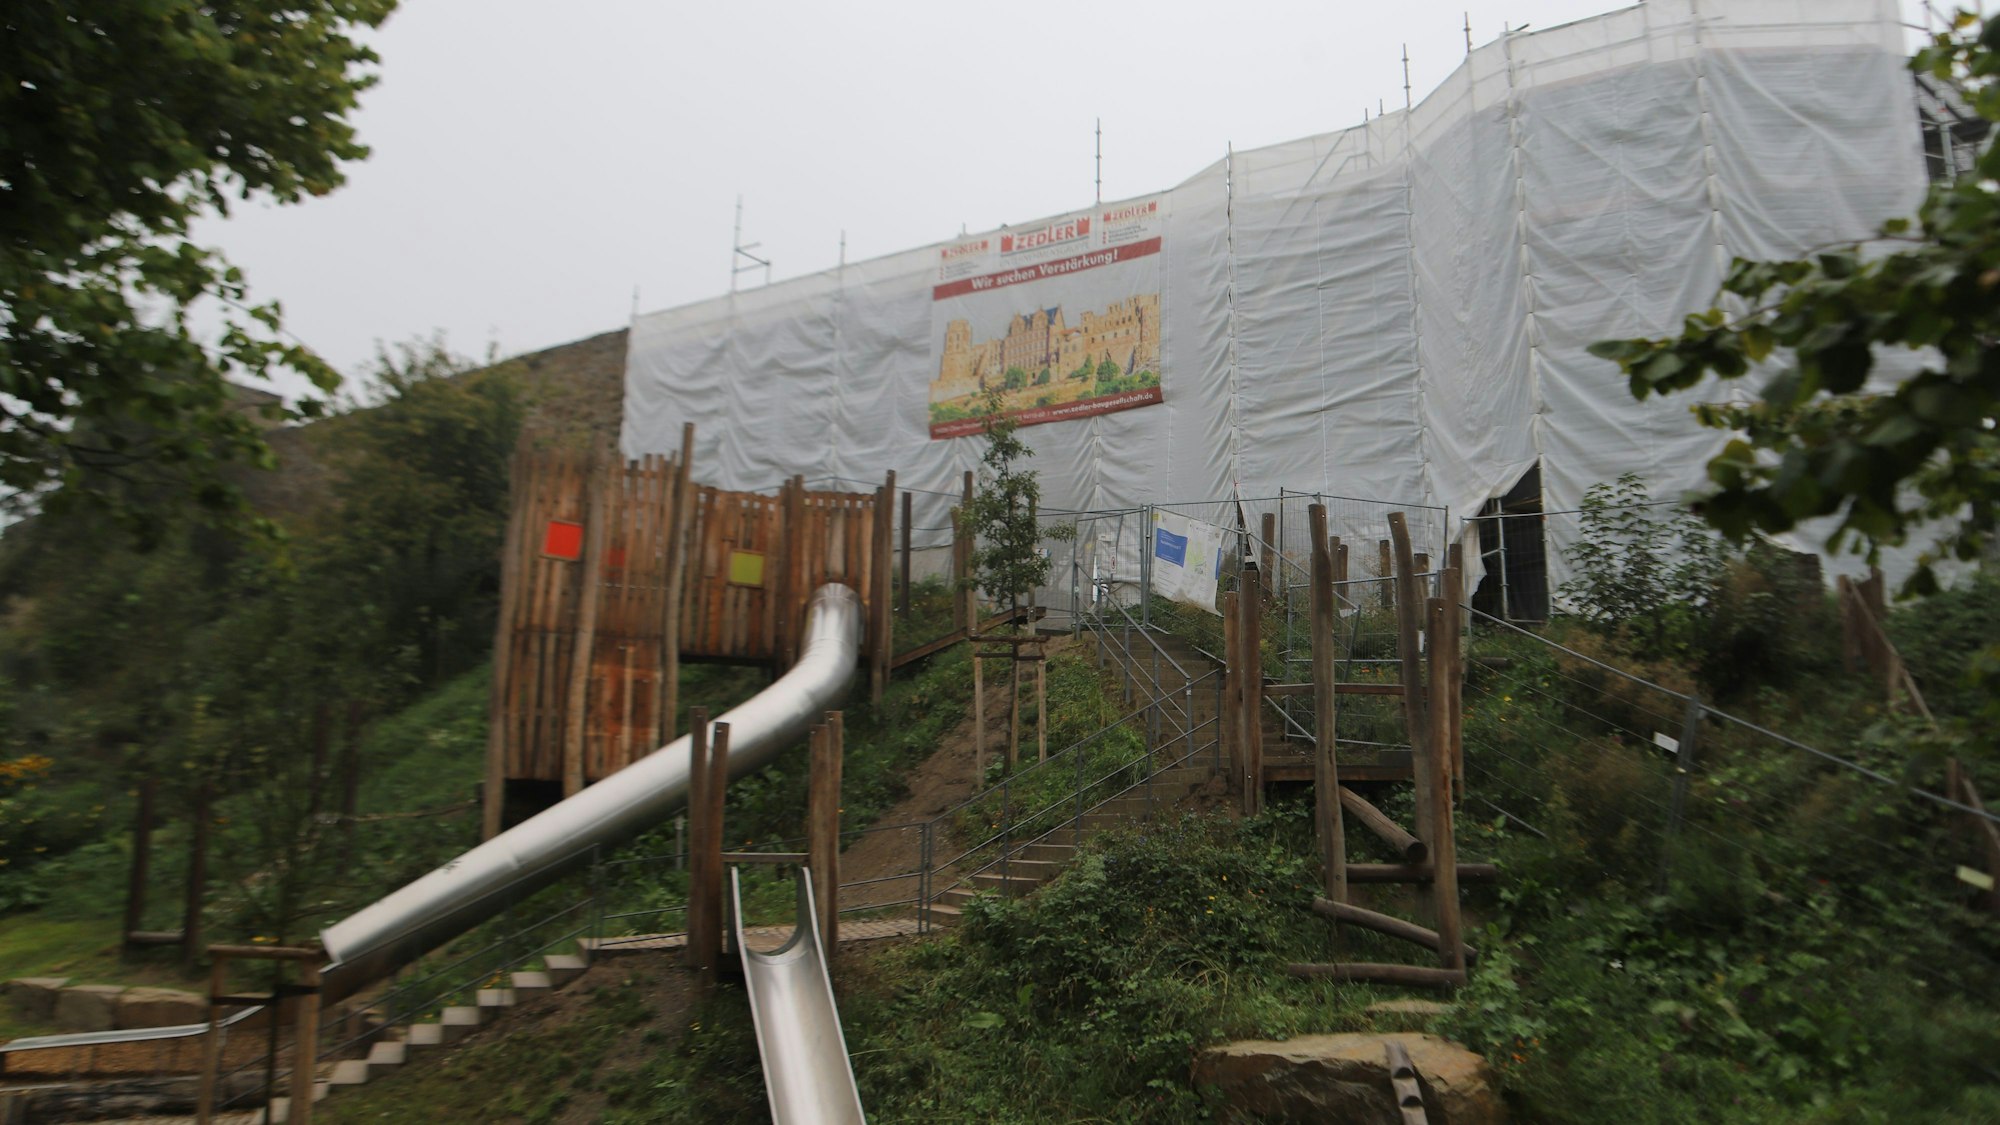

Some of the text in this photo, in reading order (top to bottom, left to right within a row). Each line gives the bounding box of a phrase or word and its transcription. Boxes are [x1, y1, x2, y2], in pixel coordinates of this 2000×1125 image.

[1112, 206, 1148, 220] ZEDLER
[1016, 224, 1075, 250] ZEDLER
[971, 276, 993, 290] Wir
[996, 269, 1036, 287] suchen
[1039, 249, 1119, 276] Verstärkung!
[1052, 392, 1154, 416] www.zedler-baugesellschaft.de
